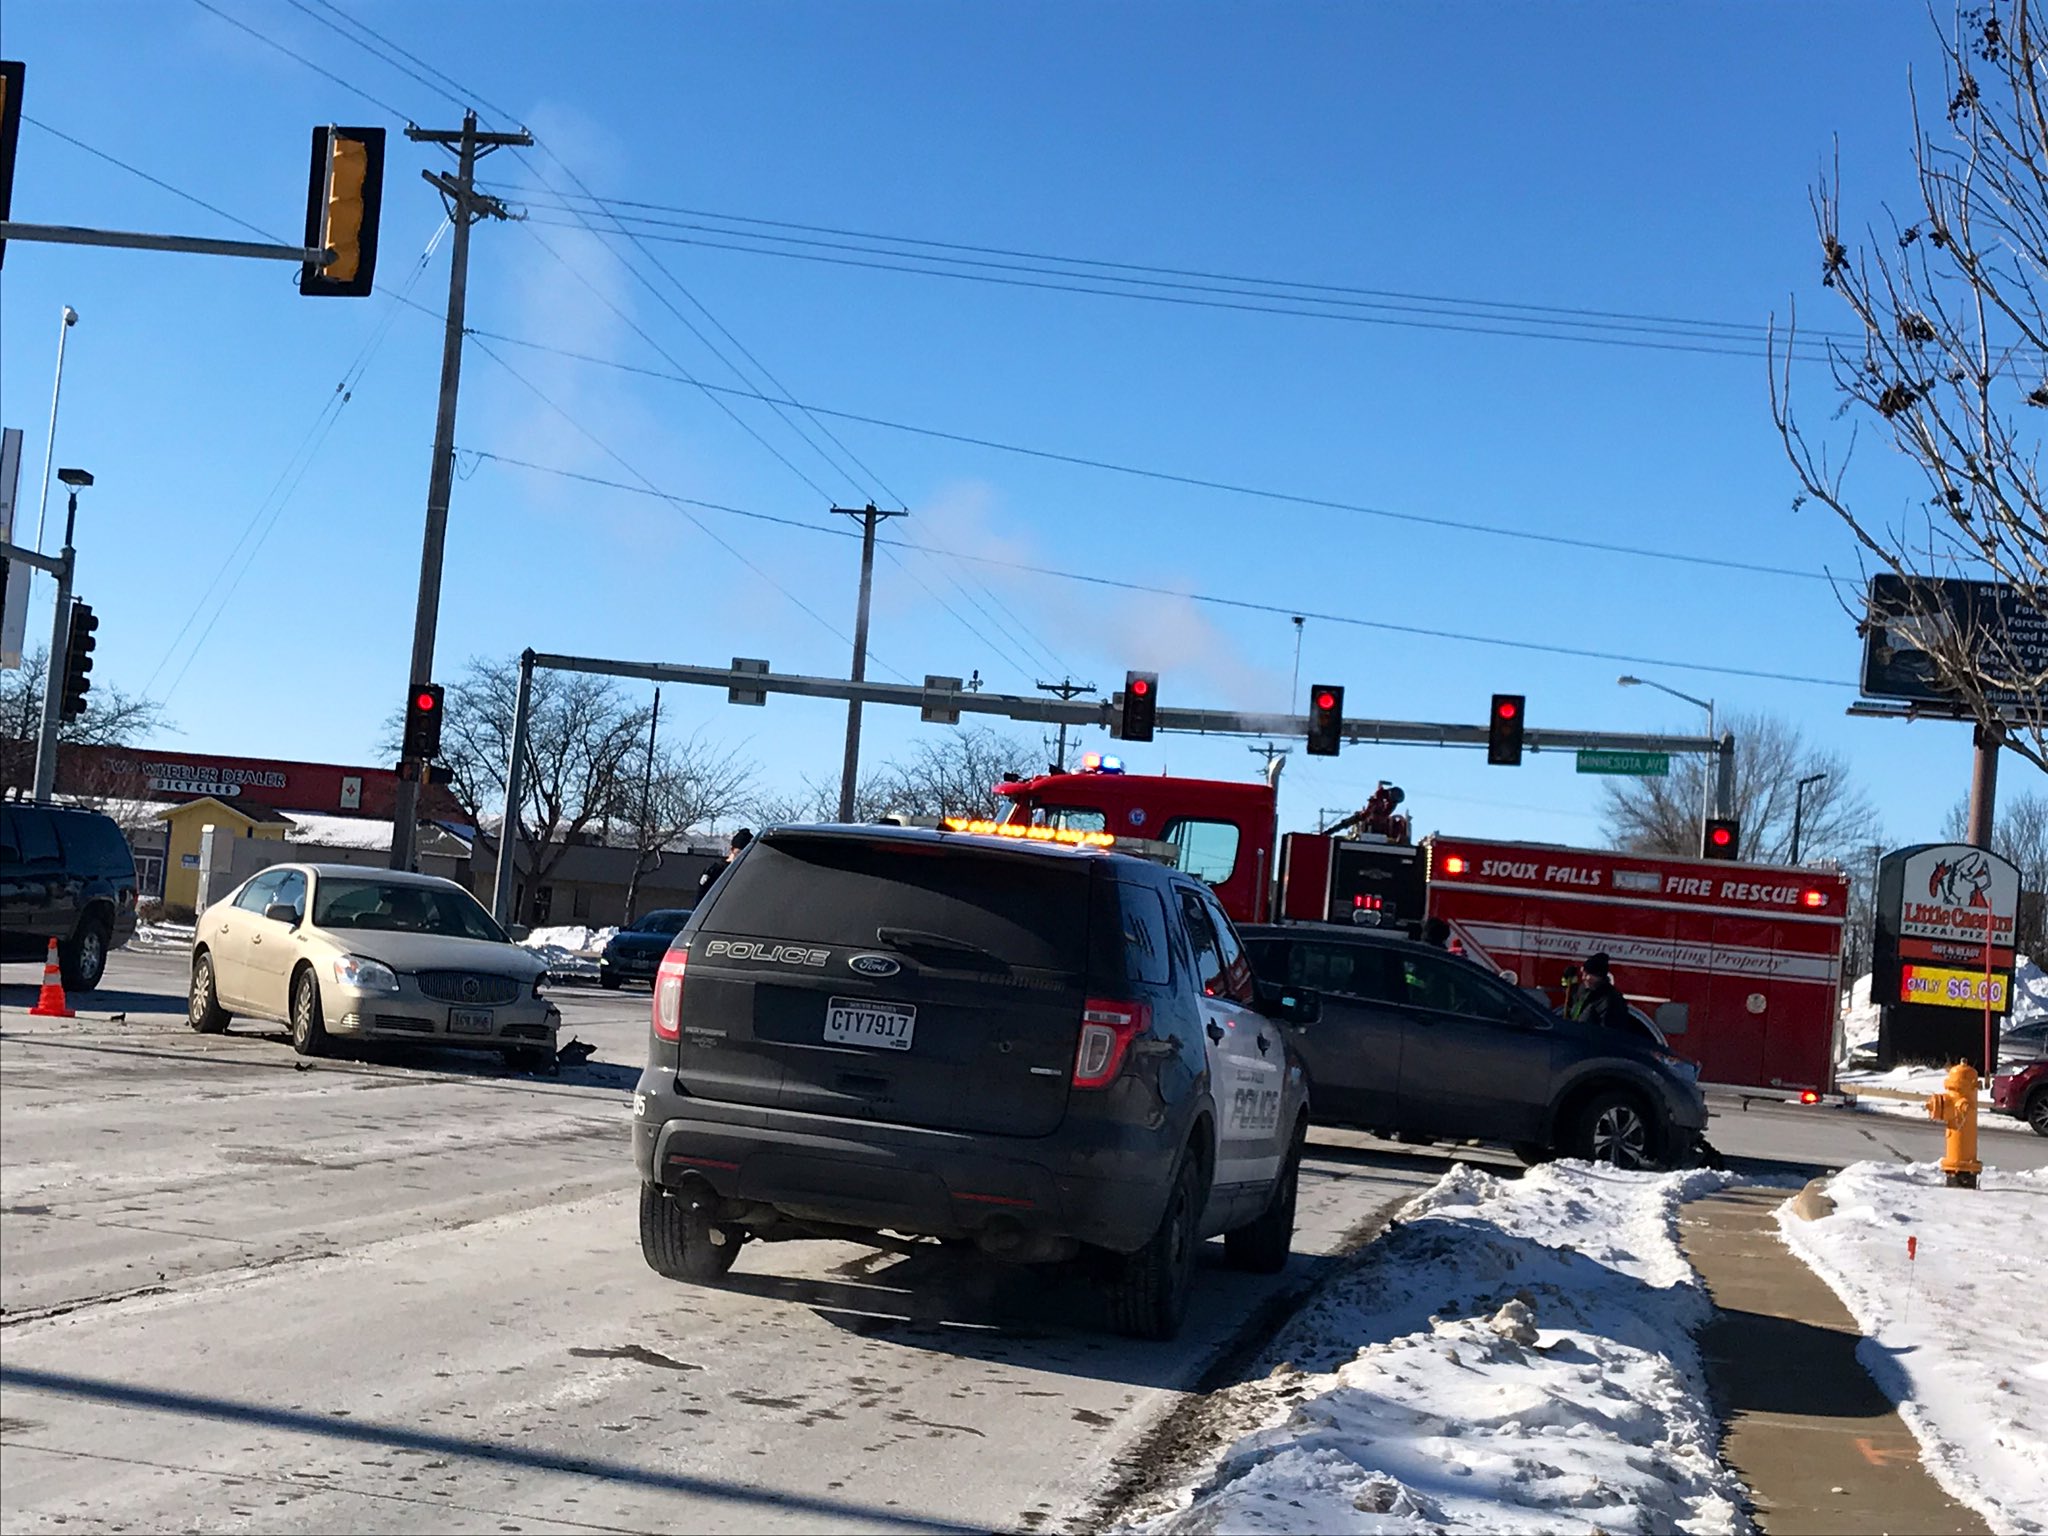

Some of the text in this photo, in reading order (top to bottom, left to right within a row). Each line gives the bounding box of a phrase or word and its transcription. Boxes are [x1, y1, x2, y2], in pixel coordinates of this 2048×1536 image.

[142, 761, 218, 783] WHEELER
[222, 768, 287, 788] DEALER
[1580, 754, 1641, 770] MINNESOTA
[157, 780, 233, 794] BICYCLES
[1480, 859, 1800, 905] SIOUX FALLS FIRE RESCUE
[1905, 924, 1955, 936] PIZZA!
[705, 940, 831, 968] POLICE
[858, 956, 890, 973] Ford
[1908, 977, 2002, 1002] ONLY $6.00
[831, 1010, 909, 1038] CTY7917
[1231, 1088, 1279, 1130] POLICE
